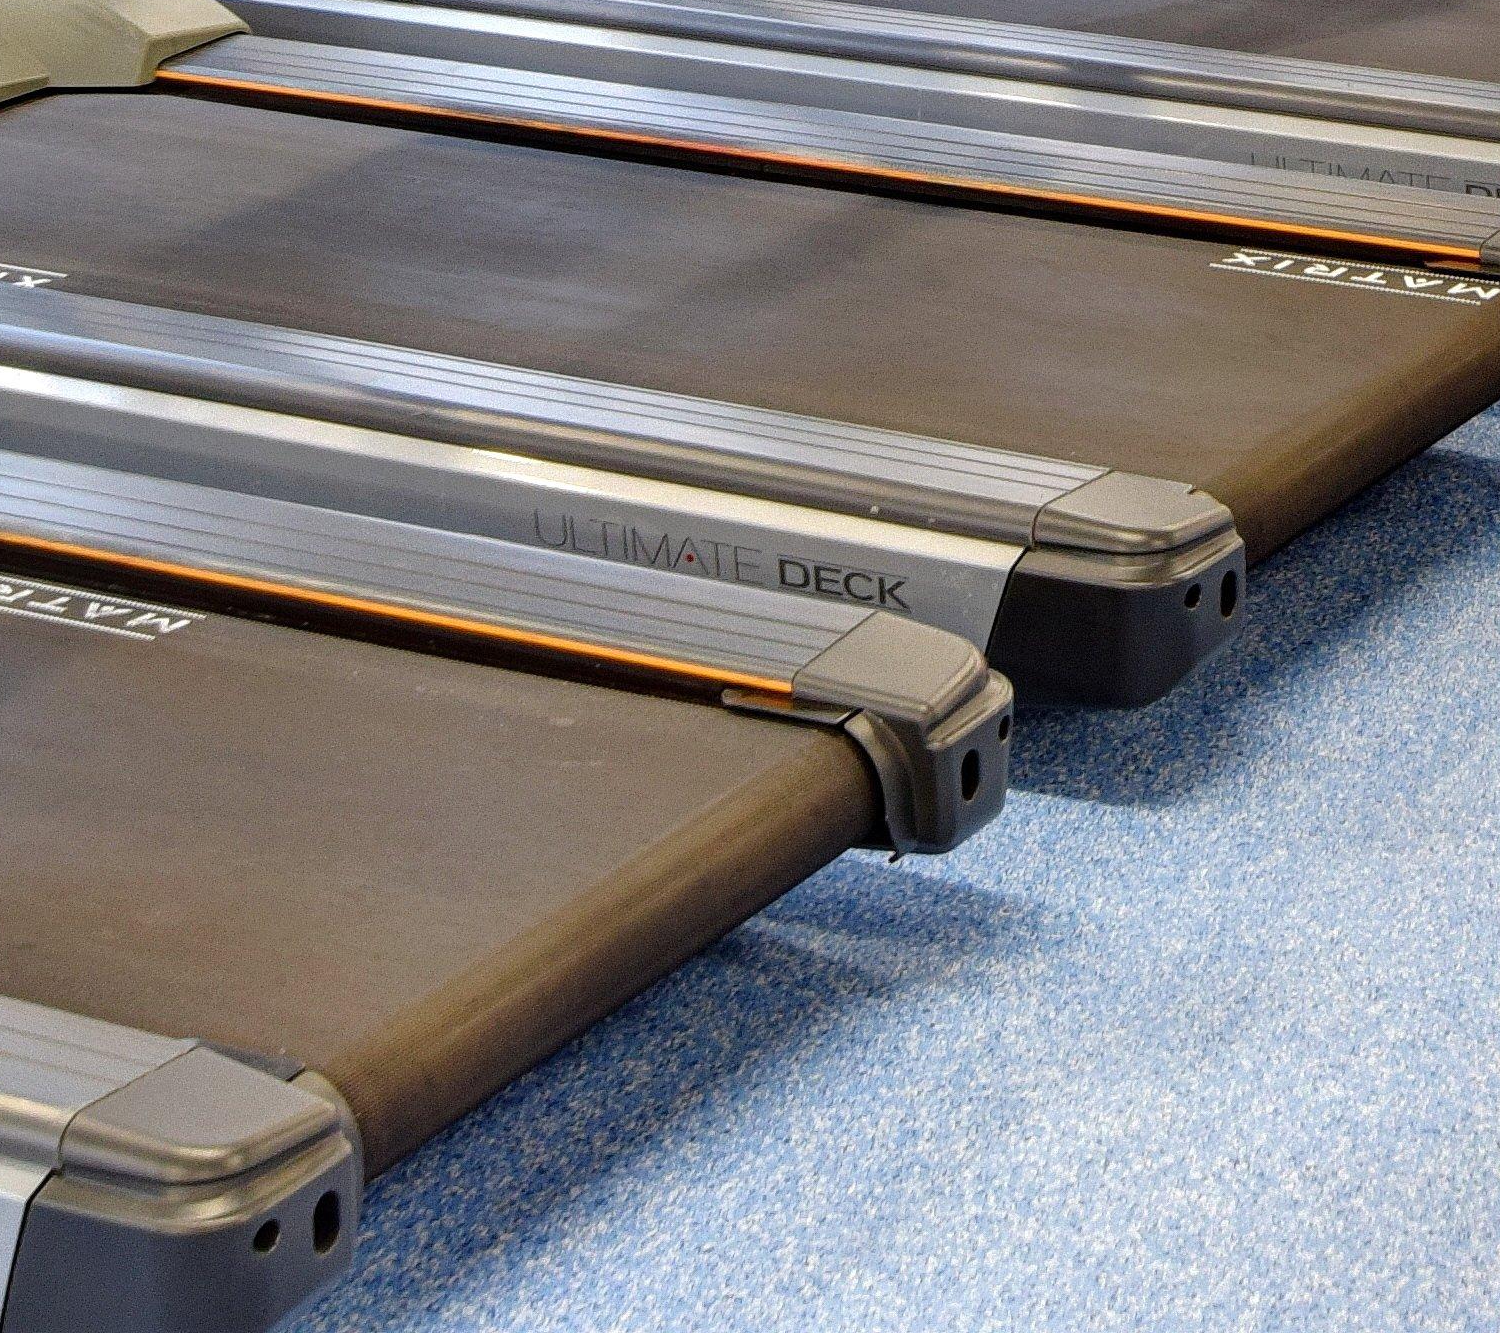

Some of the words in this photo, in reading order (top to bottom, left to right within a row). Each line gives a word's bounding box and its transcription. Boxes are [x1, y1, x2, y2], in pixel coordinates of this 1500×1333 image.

[1221, 252, 1500, 300] MATRIX
[533, 508, 765, 582] ULTIMATE
[778, 556, 912, 615] DECK
